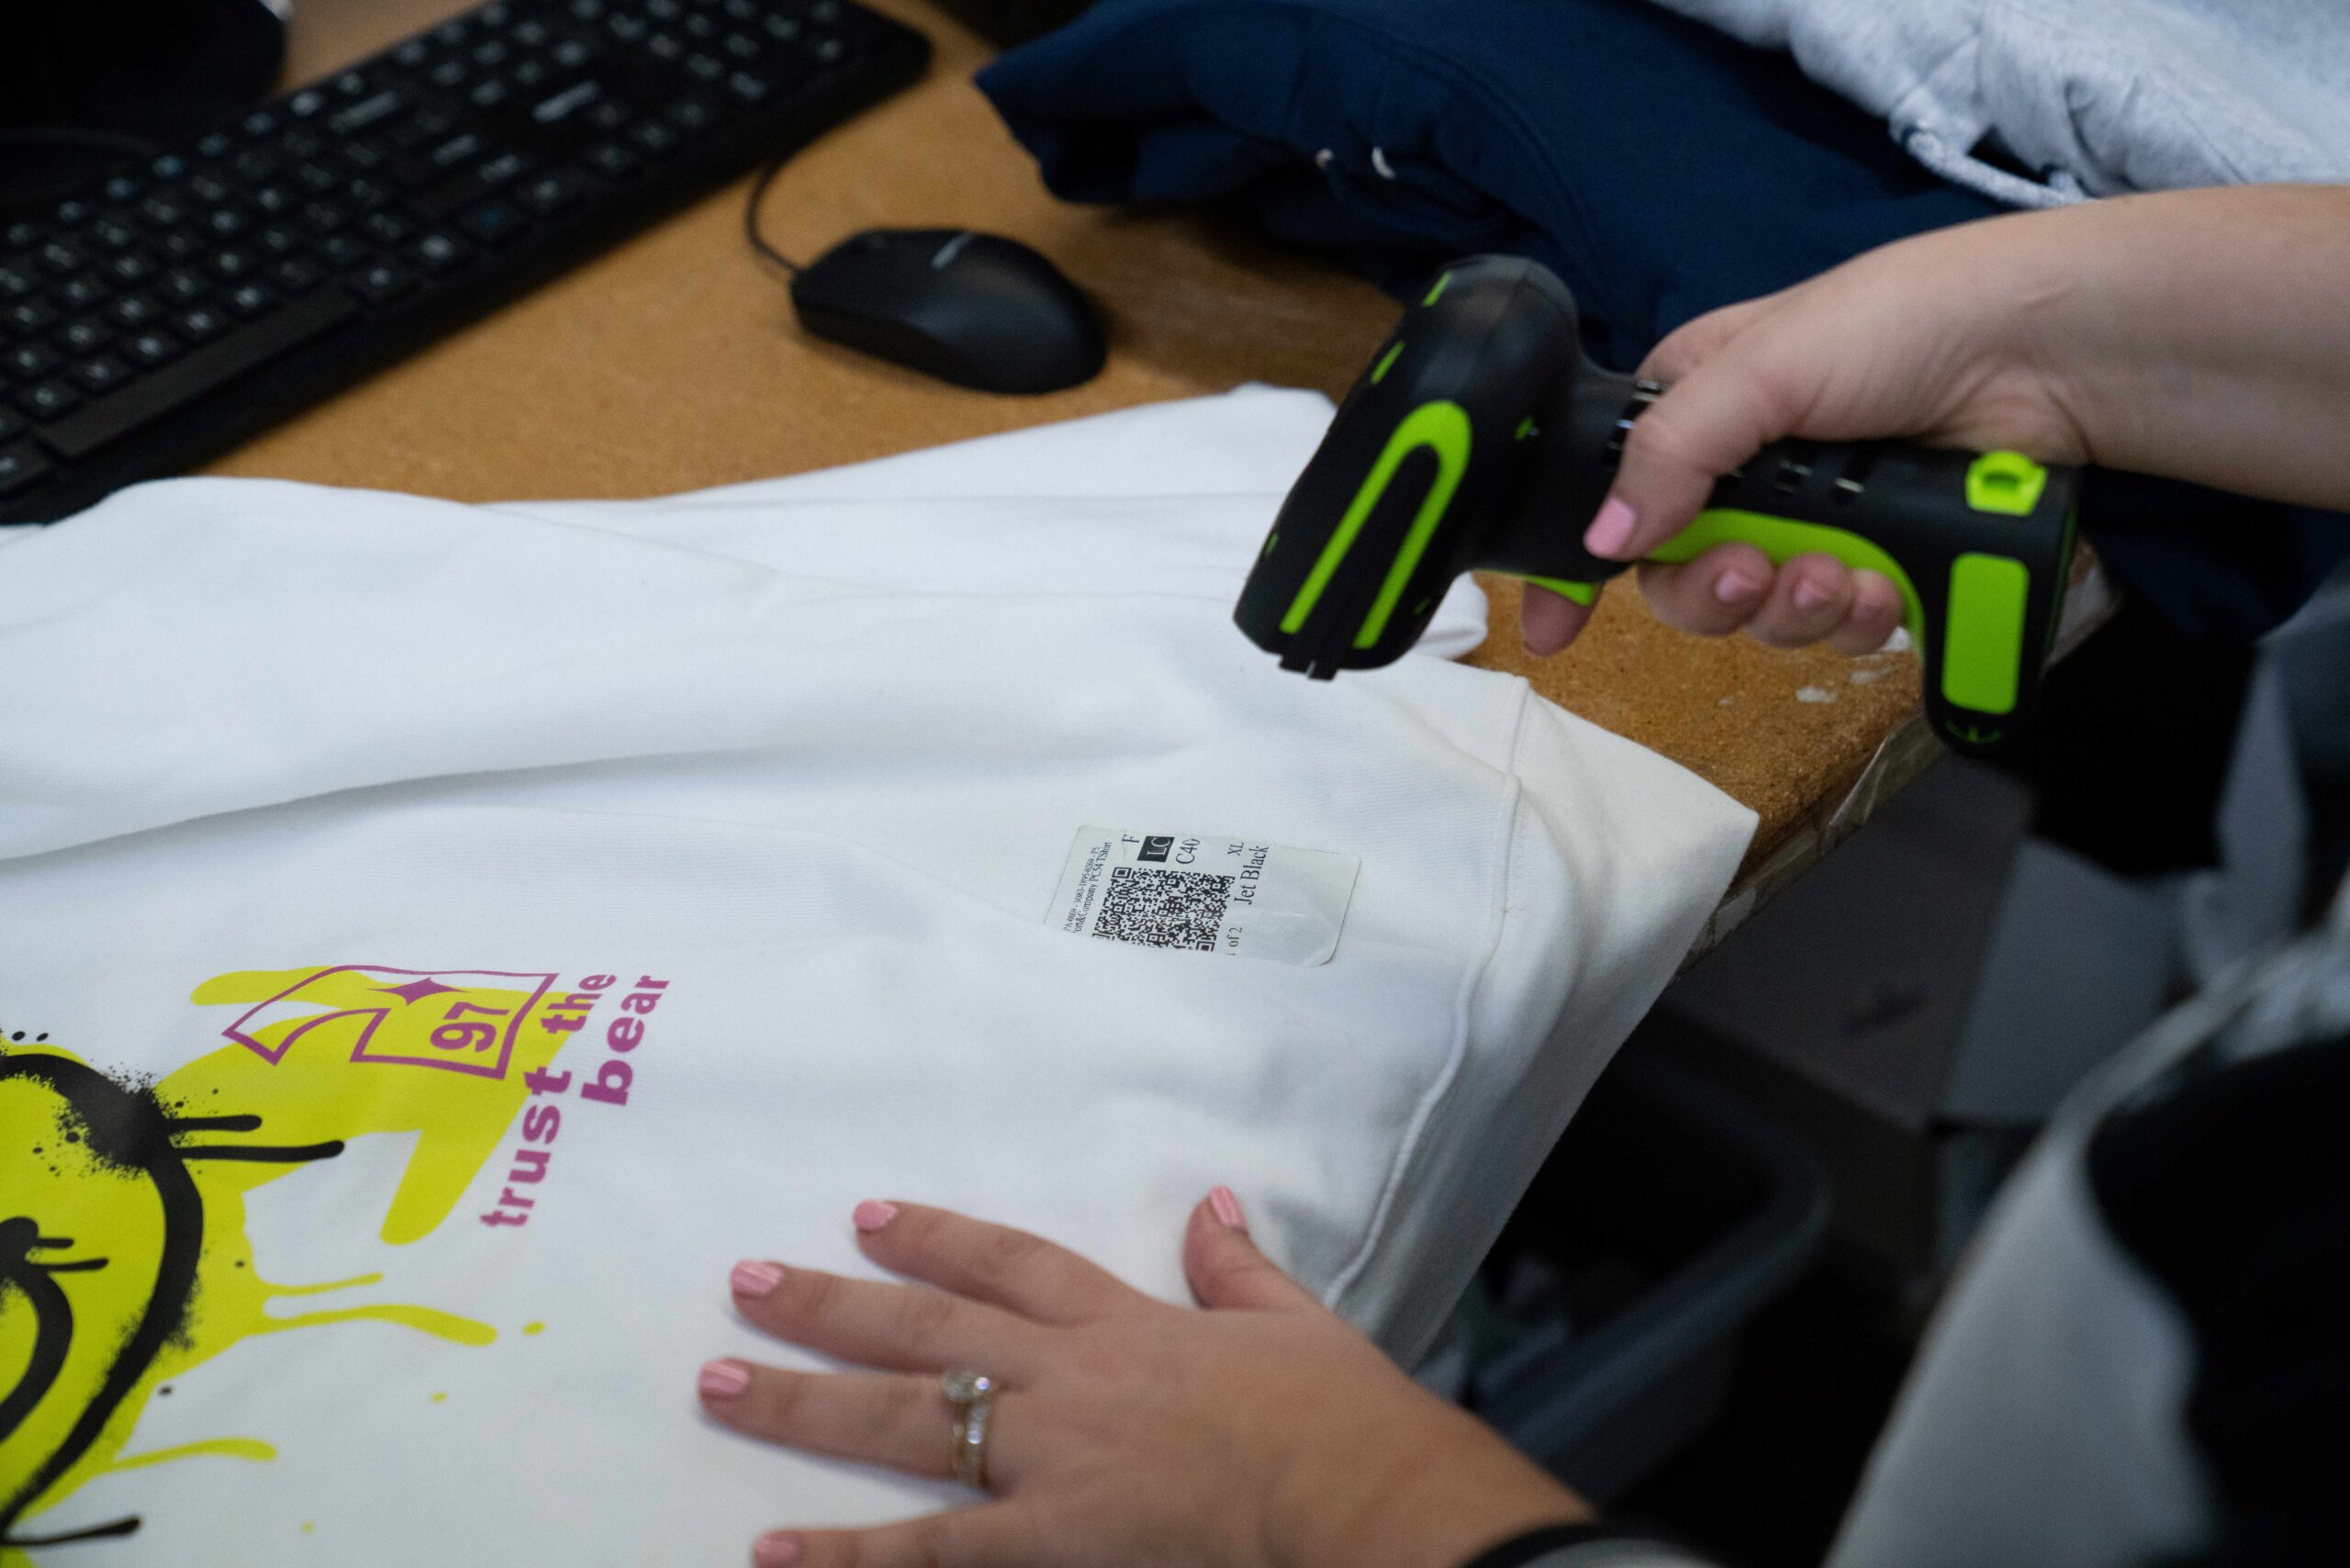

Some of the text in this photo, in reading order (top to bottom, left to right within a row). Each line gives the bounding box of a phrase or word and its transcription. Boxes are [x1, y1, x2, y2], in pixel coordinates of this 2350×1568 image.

[1122, 834, 1140, 843] F
[1147, 837, 1171, 856] LC
[1176, 838, 1201, 865] C40
[1227, 842, 1245, 856] XL
[1072, 842, 1113, 933] ort&Company PC54 TShirt
[1234, 846, 1269, 905] Jet Black
[1226, 935, 1240, 946] of
[430, 1002, 511, 1052] 97
[579, 975, 670, 1106] bear
[479, 974, 617, 1227] trust the
